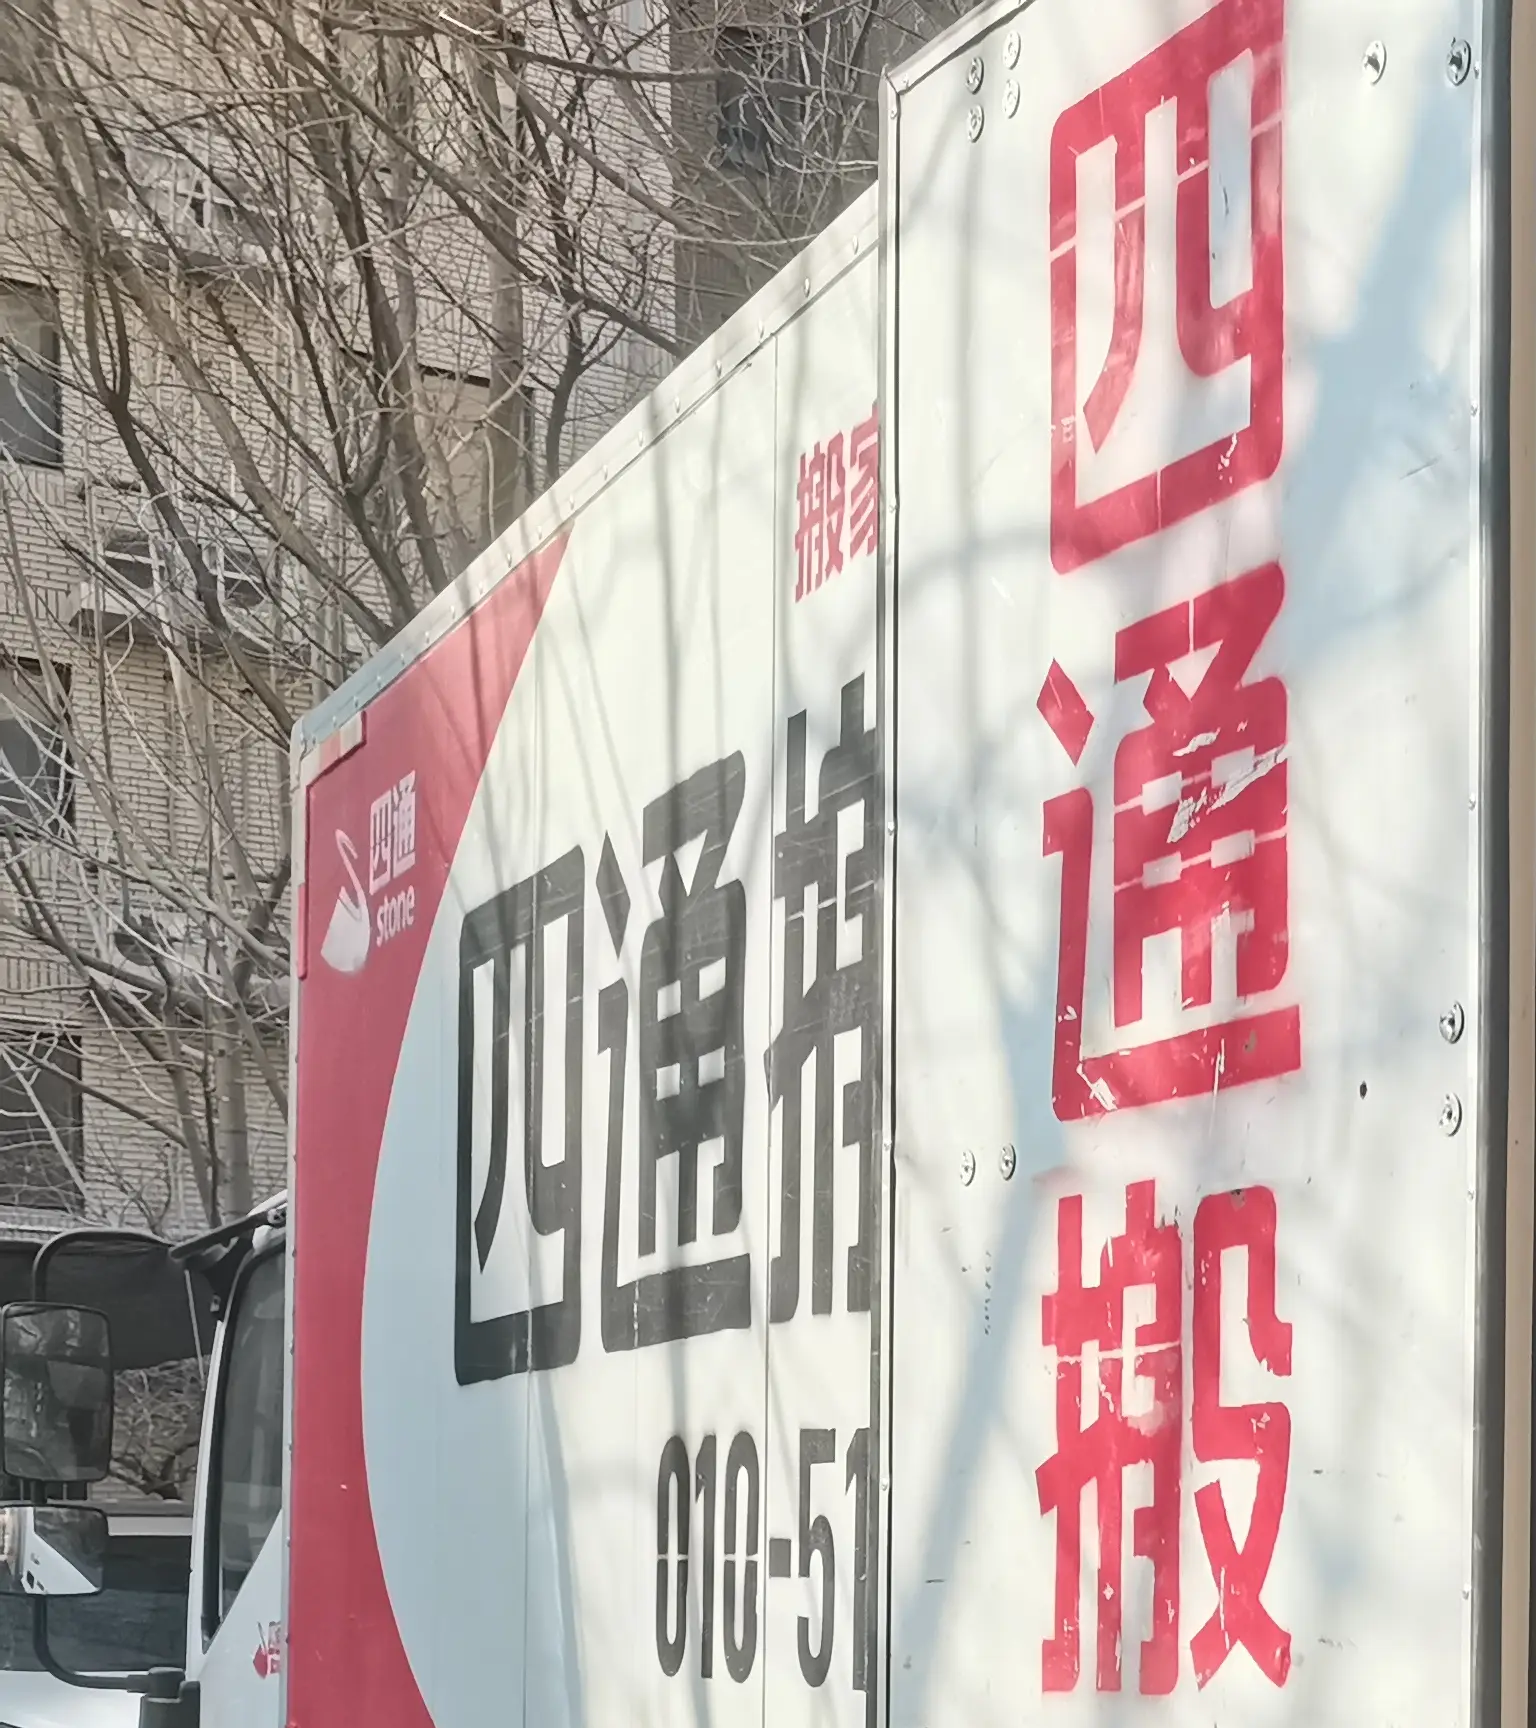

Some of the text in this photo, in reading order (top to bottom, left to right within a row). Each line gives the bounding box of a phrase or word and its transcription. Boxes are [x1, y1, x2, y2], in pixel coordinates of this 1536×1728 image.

[369, 769, 416, 895] 四通
[376, 885, 414, 948] stone
[656, 1428, 869, 1691] 010-51
